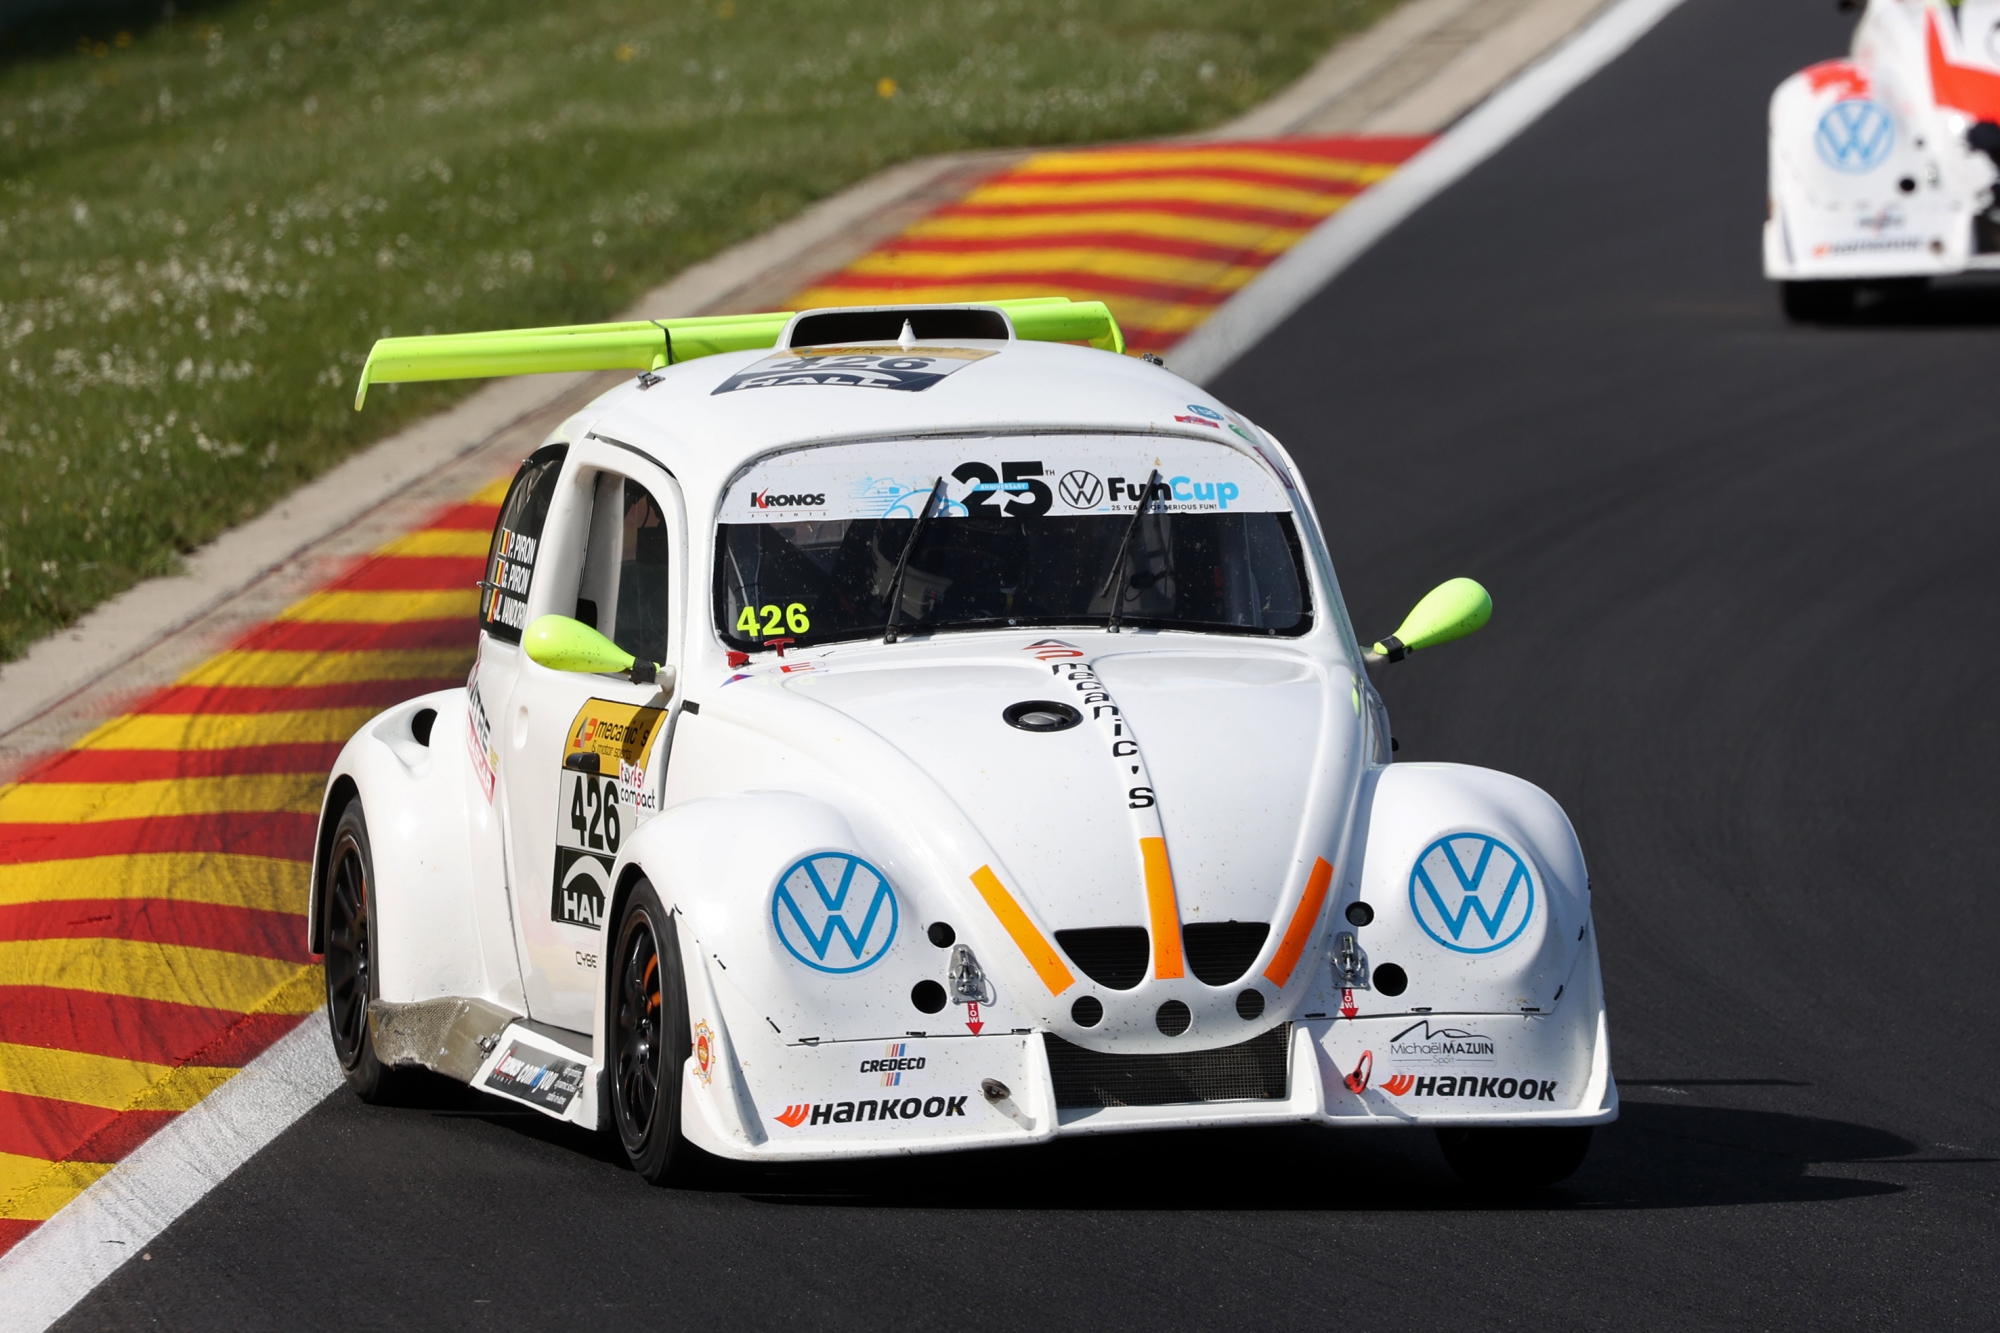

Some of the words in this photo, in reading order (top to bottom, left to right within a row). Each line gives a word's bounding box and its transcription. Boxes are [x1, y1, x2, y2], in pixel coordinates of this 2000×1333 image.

[770, 356, 936, 370] 426
[734, 377, 890, 389] HALL
[750, 487, 825, 509] KRONOS
[951, 461, 1053, 517] 25
[980, 483, 1026, 491] ANNIVERSARY
[1108, 476, 1239, 509] FunCup
[1164, 503, 1198, 511] SERIOUS
[1200, 502, 1218, 510] FUN!
[513, 533, 537, 566] PIRON
[507, 563, 531, 595] PIRON
[737, 603, 810, 637] 426
[594, 720, 650, 747] mecanic's
[1052, 662, 1155, 809] mecanic's
[597, 743, 614, 757] motor
[614, 746, 632, 761] sports
[620, 787, 656, 815] compact
[571, 775, 621, 854] 426
[969, 1003, 979, 1024] TOW
[1442, 1042, 1494, 1055] MAZUIN
[860, 1057, 926, 1074] CREDECO
[1432, 1055, 1455, 1065] Sport
